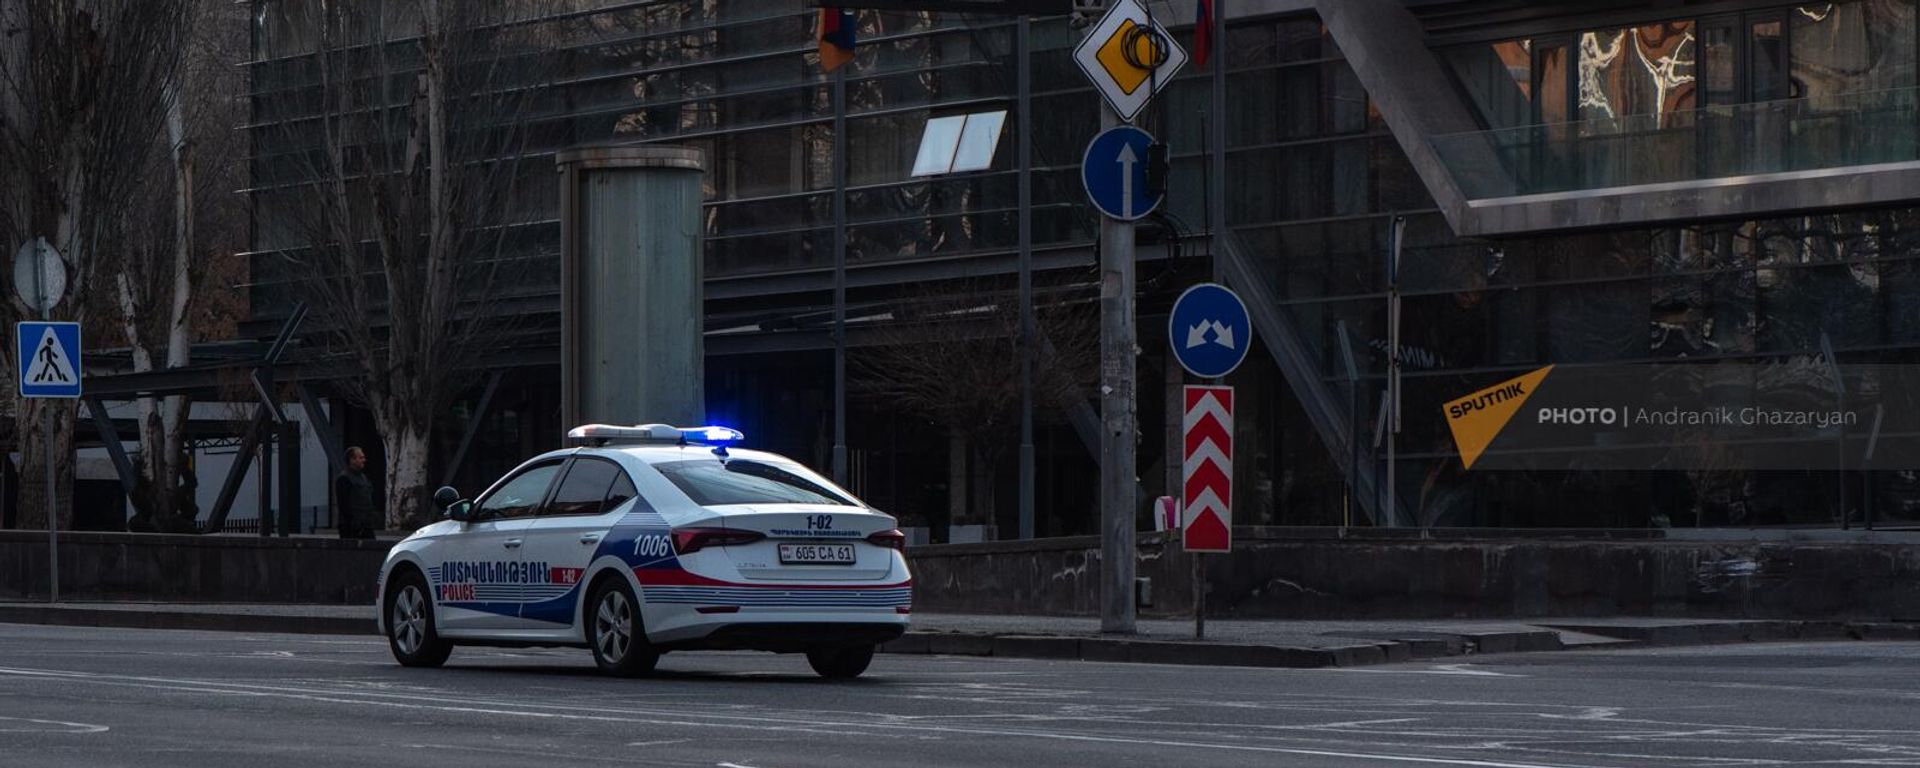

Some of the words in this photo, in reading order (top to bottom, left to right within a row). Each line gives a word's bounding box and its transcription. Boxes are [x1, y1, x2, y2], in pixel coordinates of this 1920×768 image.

[806, 514, 833, 530] 1-02
[633, 534, 671, 557] 1006
[795, 546, 816, 560] 605
[818, 546, 836, 560] CA
[838, 546, 852, 560] 61
[442, 561, 550, 584] ՈՍՏԻԿԱՆՈՒԹՅՈՒՆ
[562, 568, 576, 583] 1-02
[442, 584, 475, 601] POLICE
